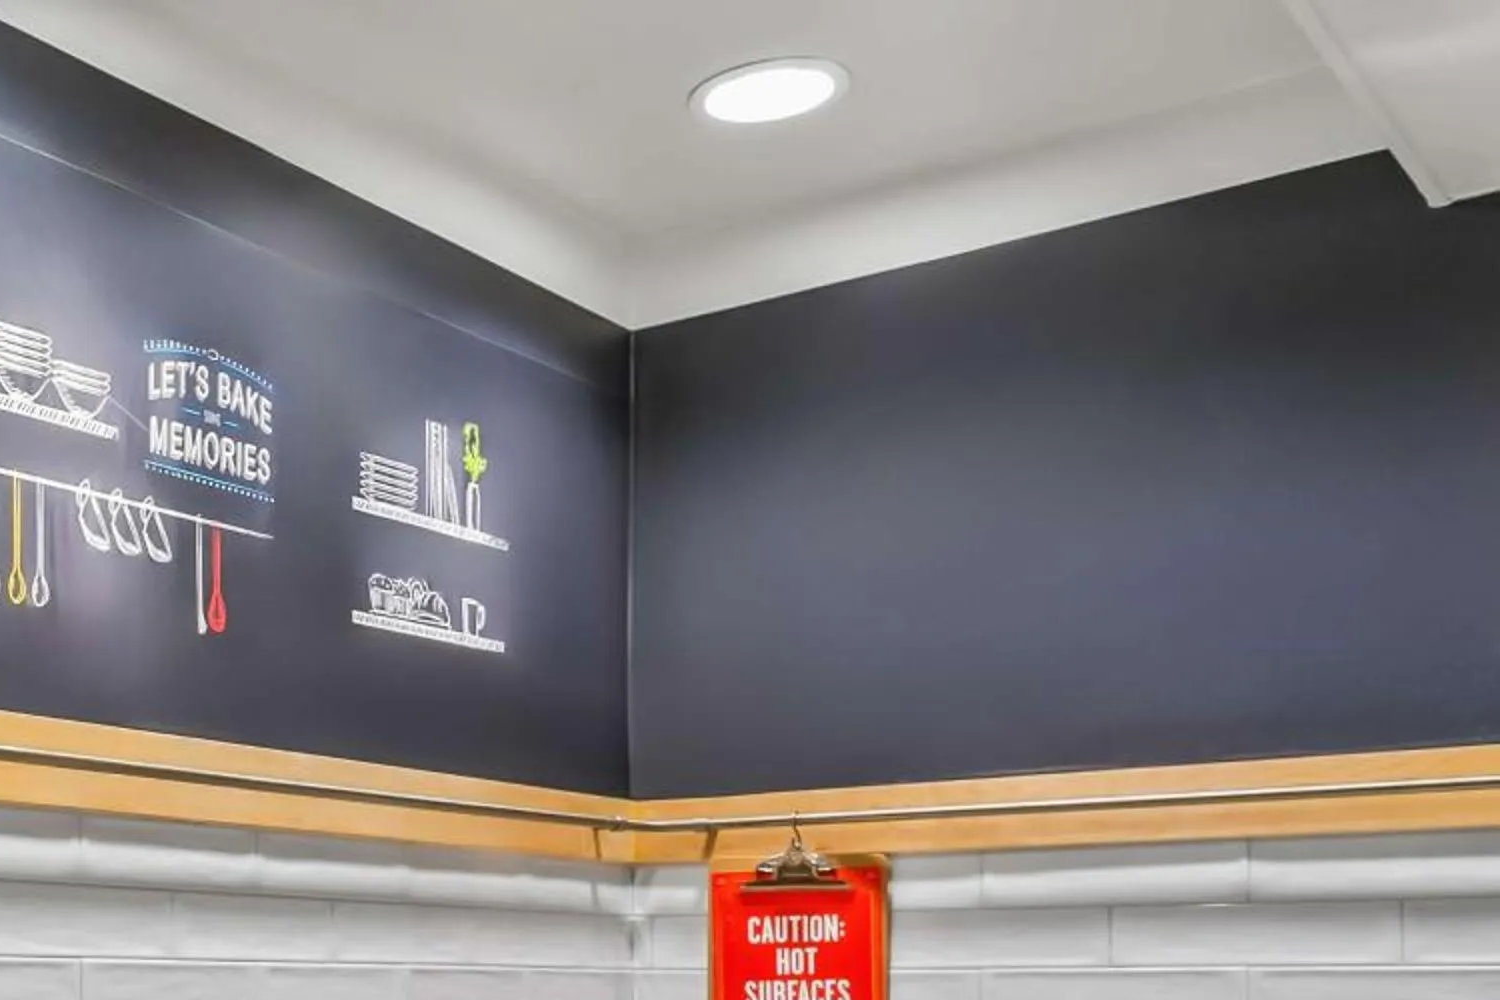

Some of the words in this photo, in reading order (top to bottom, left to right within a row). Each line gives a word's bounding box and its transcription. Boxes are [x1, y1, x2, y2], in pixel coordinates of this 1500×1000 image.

[147, 360, 209, 402] LET'S
[218, 372, 273, 434] BAKE
[149, 415, 271, 485] MEMORIES
[747, 914, 846, 944] CAUTION:
[776, 947, 818, 976] HOT
